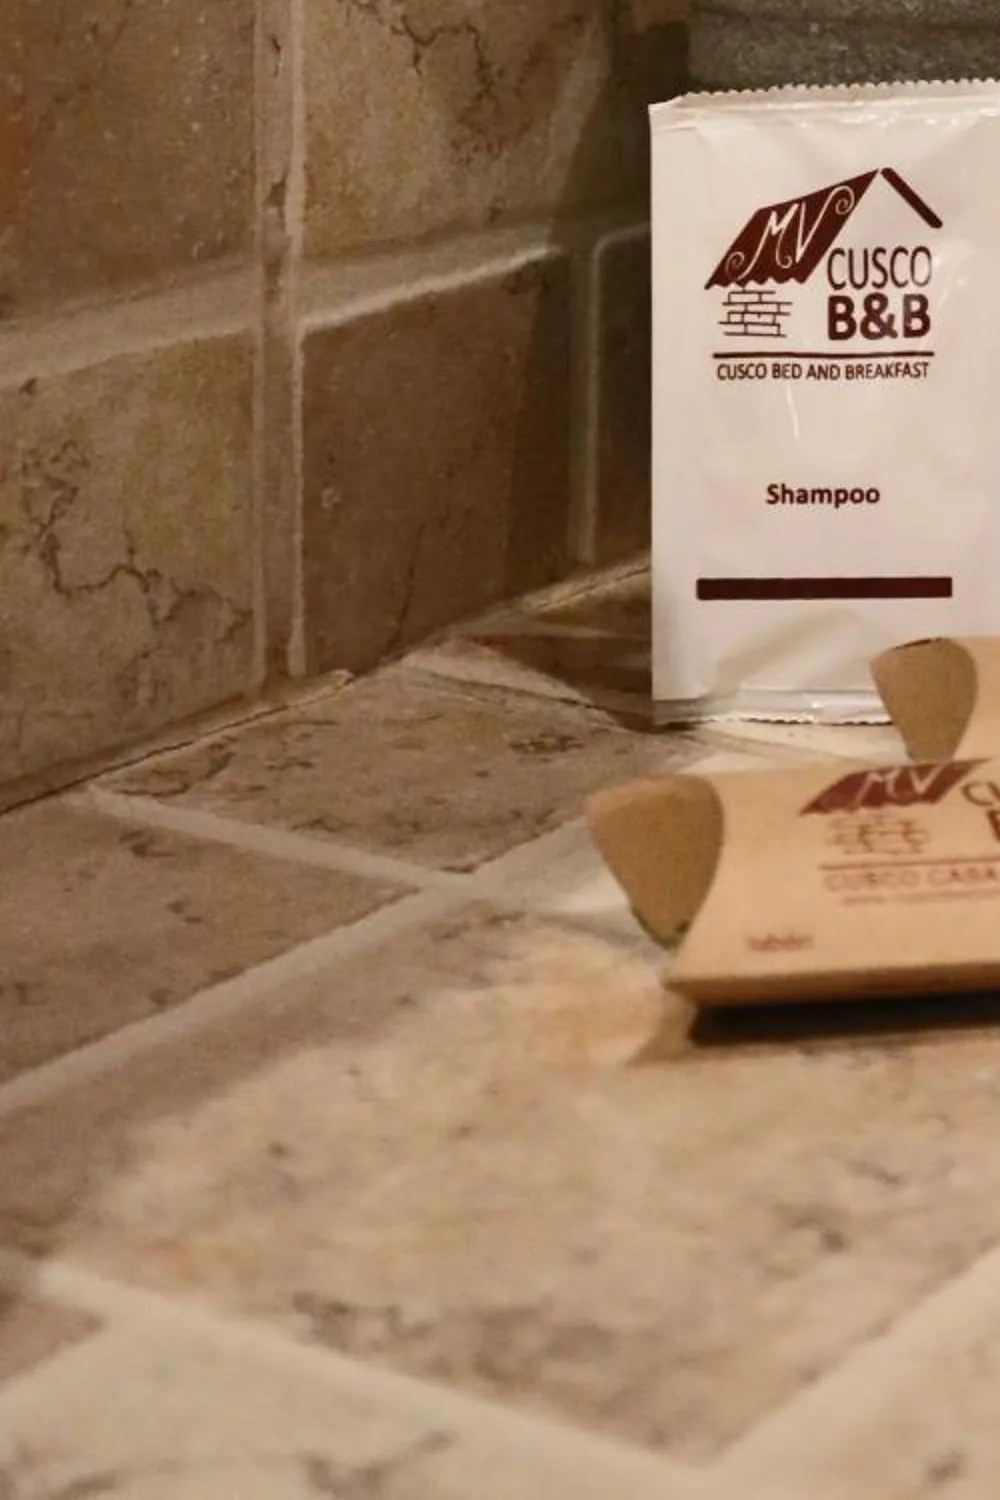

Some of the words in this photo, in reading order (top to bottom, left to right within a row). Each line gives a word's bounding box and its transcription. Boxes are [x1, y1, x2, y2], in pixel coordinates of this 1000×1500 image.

[827, 245, 932, 290] CUSCO
[828, 292, 931, 341] B&B
[716, 362, 767, 381] CUSCO
[772, 362, 801, 380] BED
[806, 363, 840, 381] AND
[845, 361, 929, 380] BREAKFAST
[766, 484, 880, 509] Shampoo
